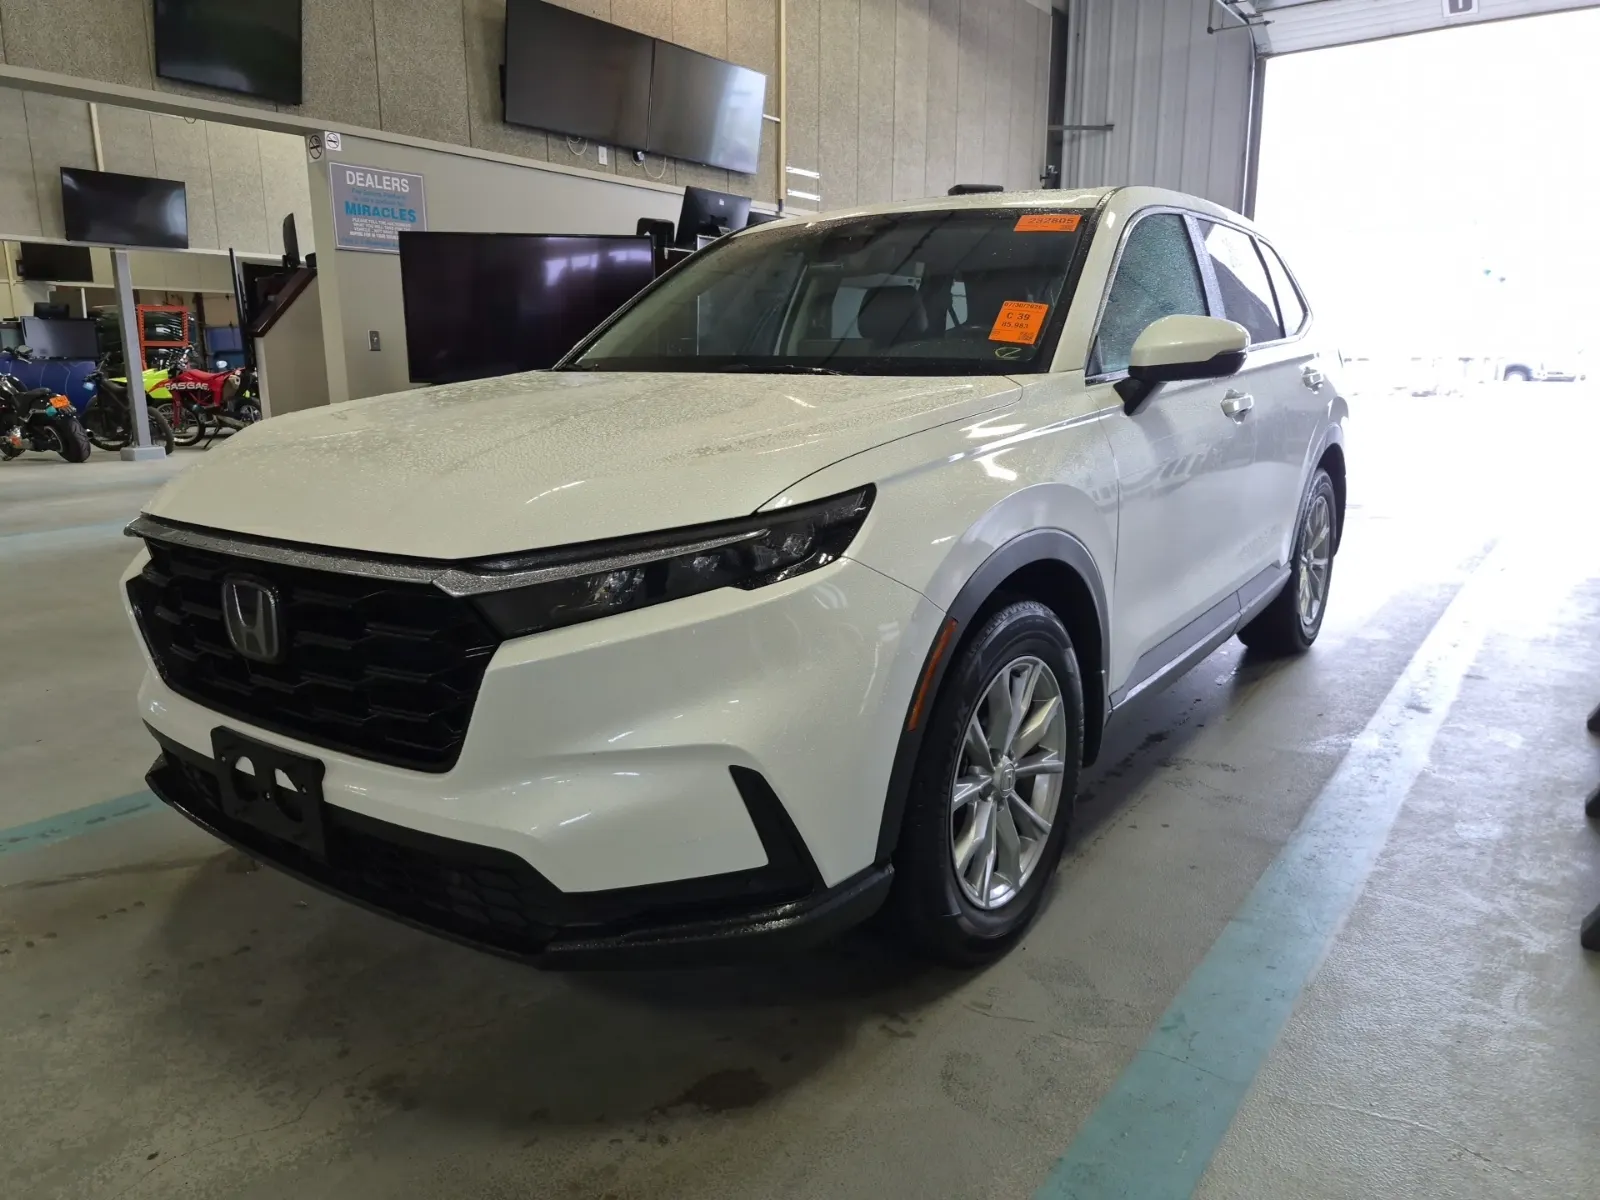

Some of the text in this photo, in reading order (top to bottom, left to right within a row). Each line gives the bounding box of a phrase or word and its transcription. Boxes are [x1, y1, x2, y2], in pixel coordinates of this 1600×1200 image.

[345, 170, 410, 193] DEALERS
[344, 200, 417, 223] MIRACLES
[1017, 313, 1031, 321] 39
[165, 381, 210, 391] GASGAS
